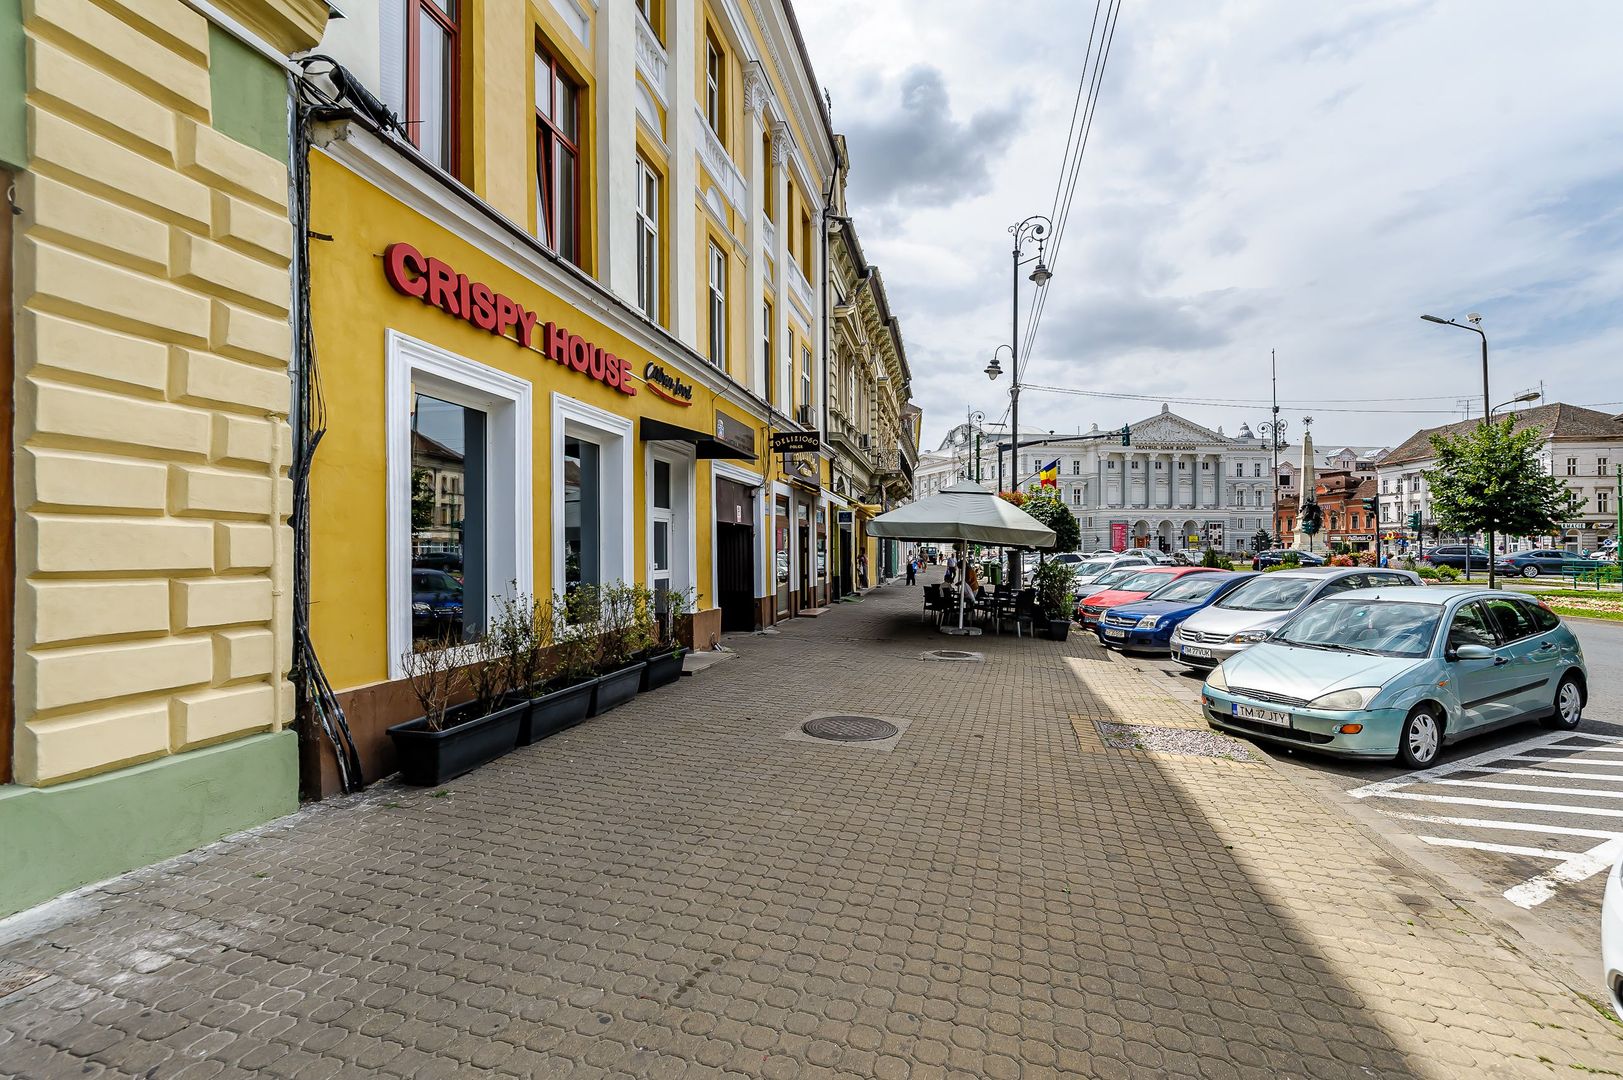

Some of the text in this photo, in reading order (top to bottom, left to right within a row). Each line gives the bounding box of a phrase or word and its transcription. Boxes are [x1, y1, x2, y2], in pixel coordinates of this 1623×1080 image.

[384, 242, 537, 348] CRISPY
[1240, 706, 1254, 718] TM
[1268, 712, 1286, 724] JTY
